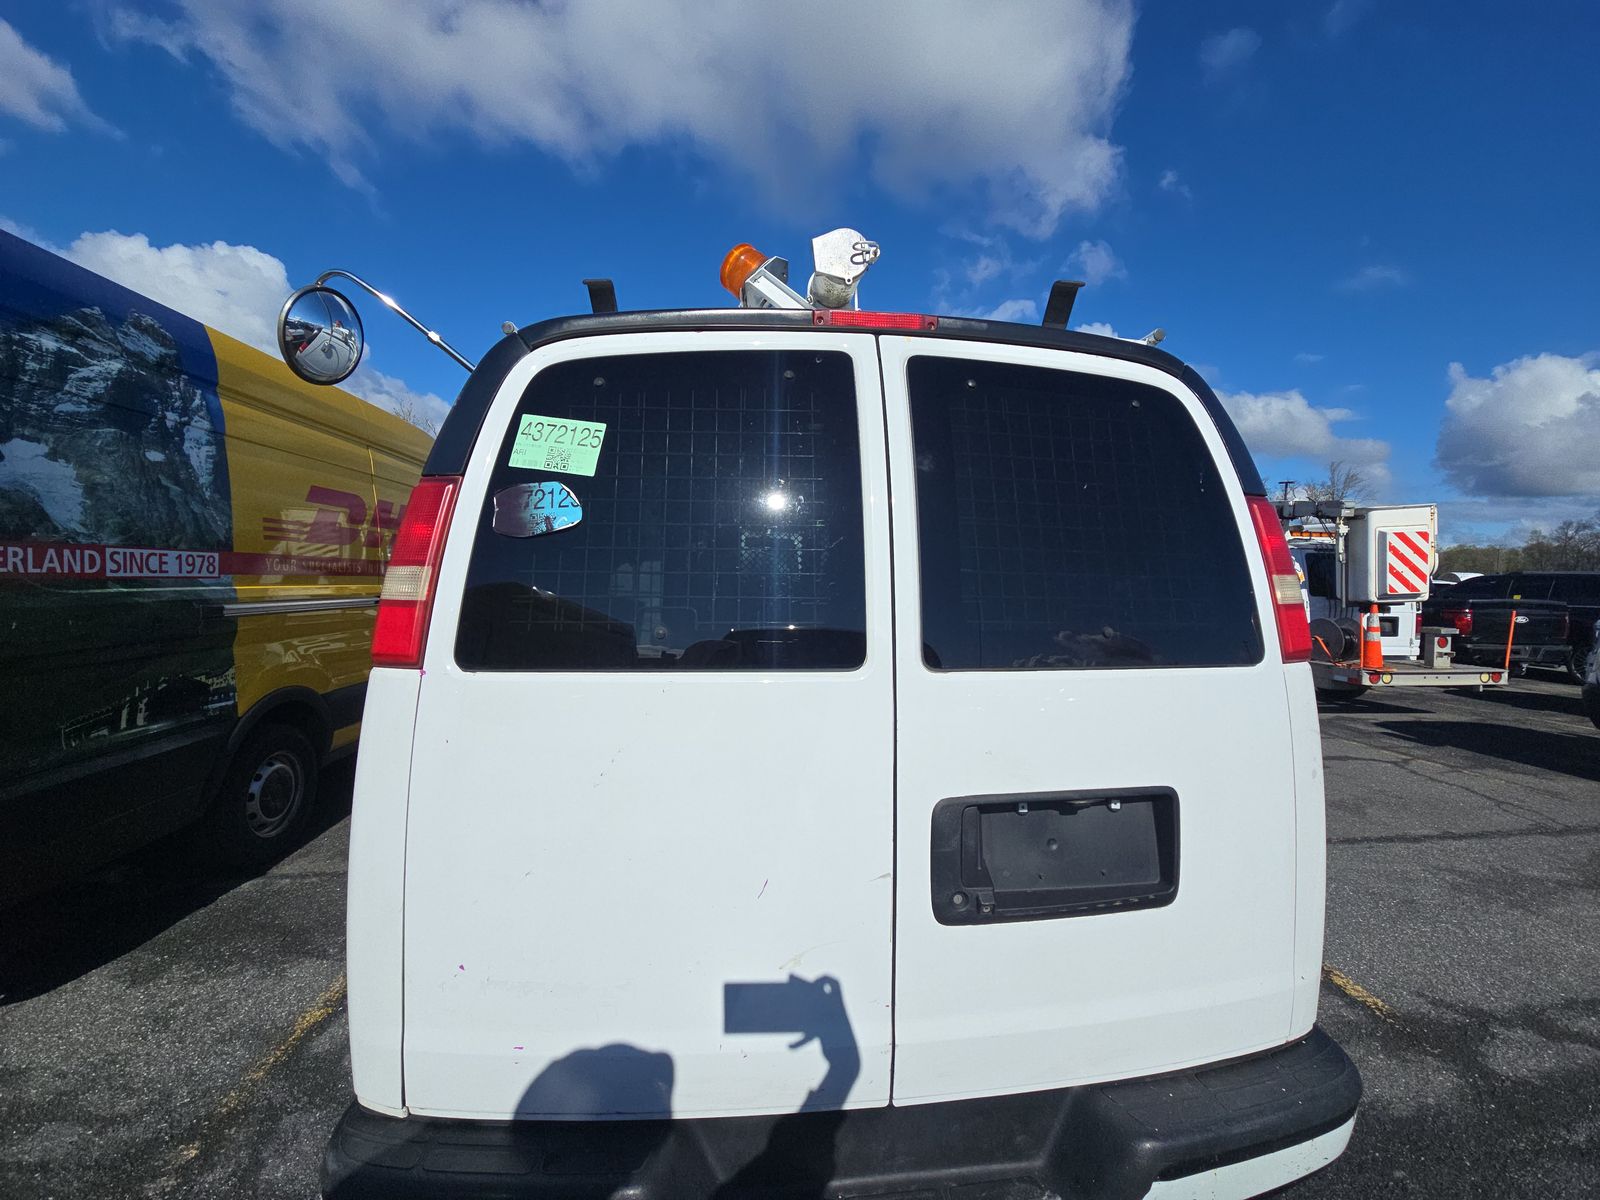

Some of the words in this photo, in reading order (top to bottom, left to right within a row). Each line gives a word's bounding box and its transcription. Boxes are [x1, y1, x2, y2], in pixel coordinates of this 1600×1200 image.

[521, 421, 603, 449] 4372125
[109, 551, 169, 574] SINCE
[175, 554, 216, 575] 1978
